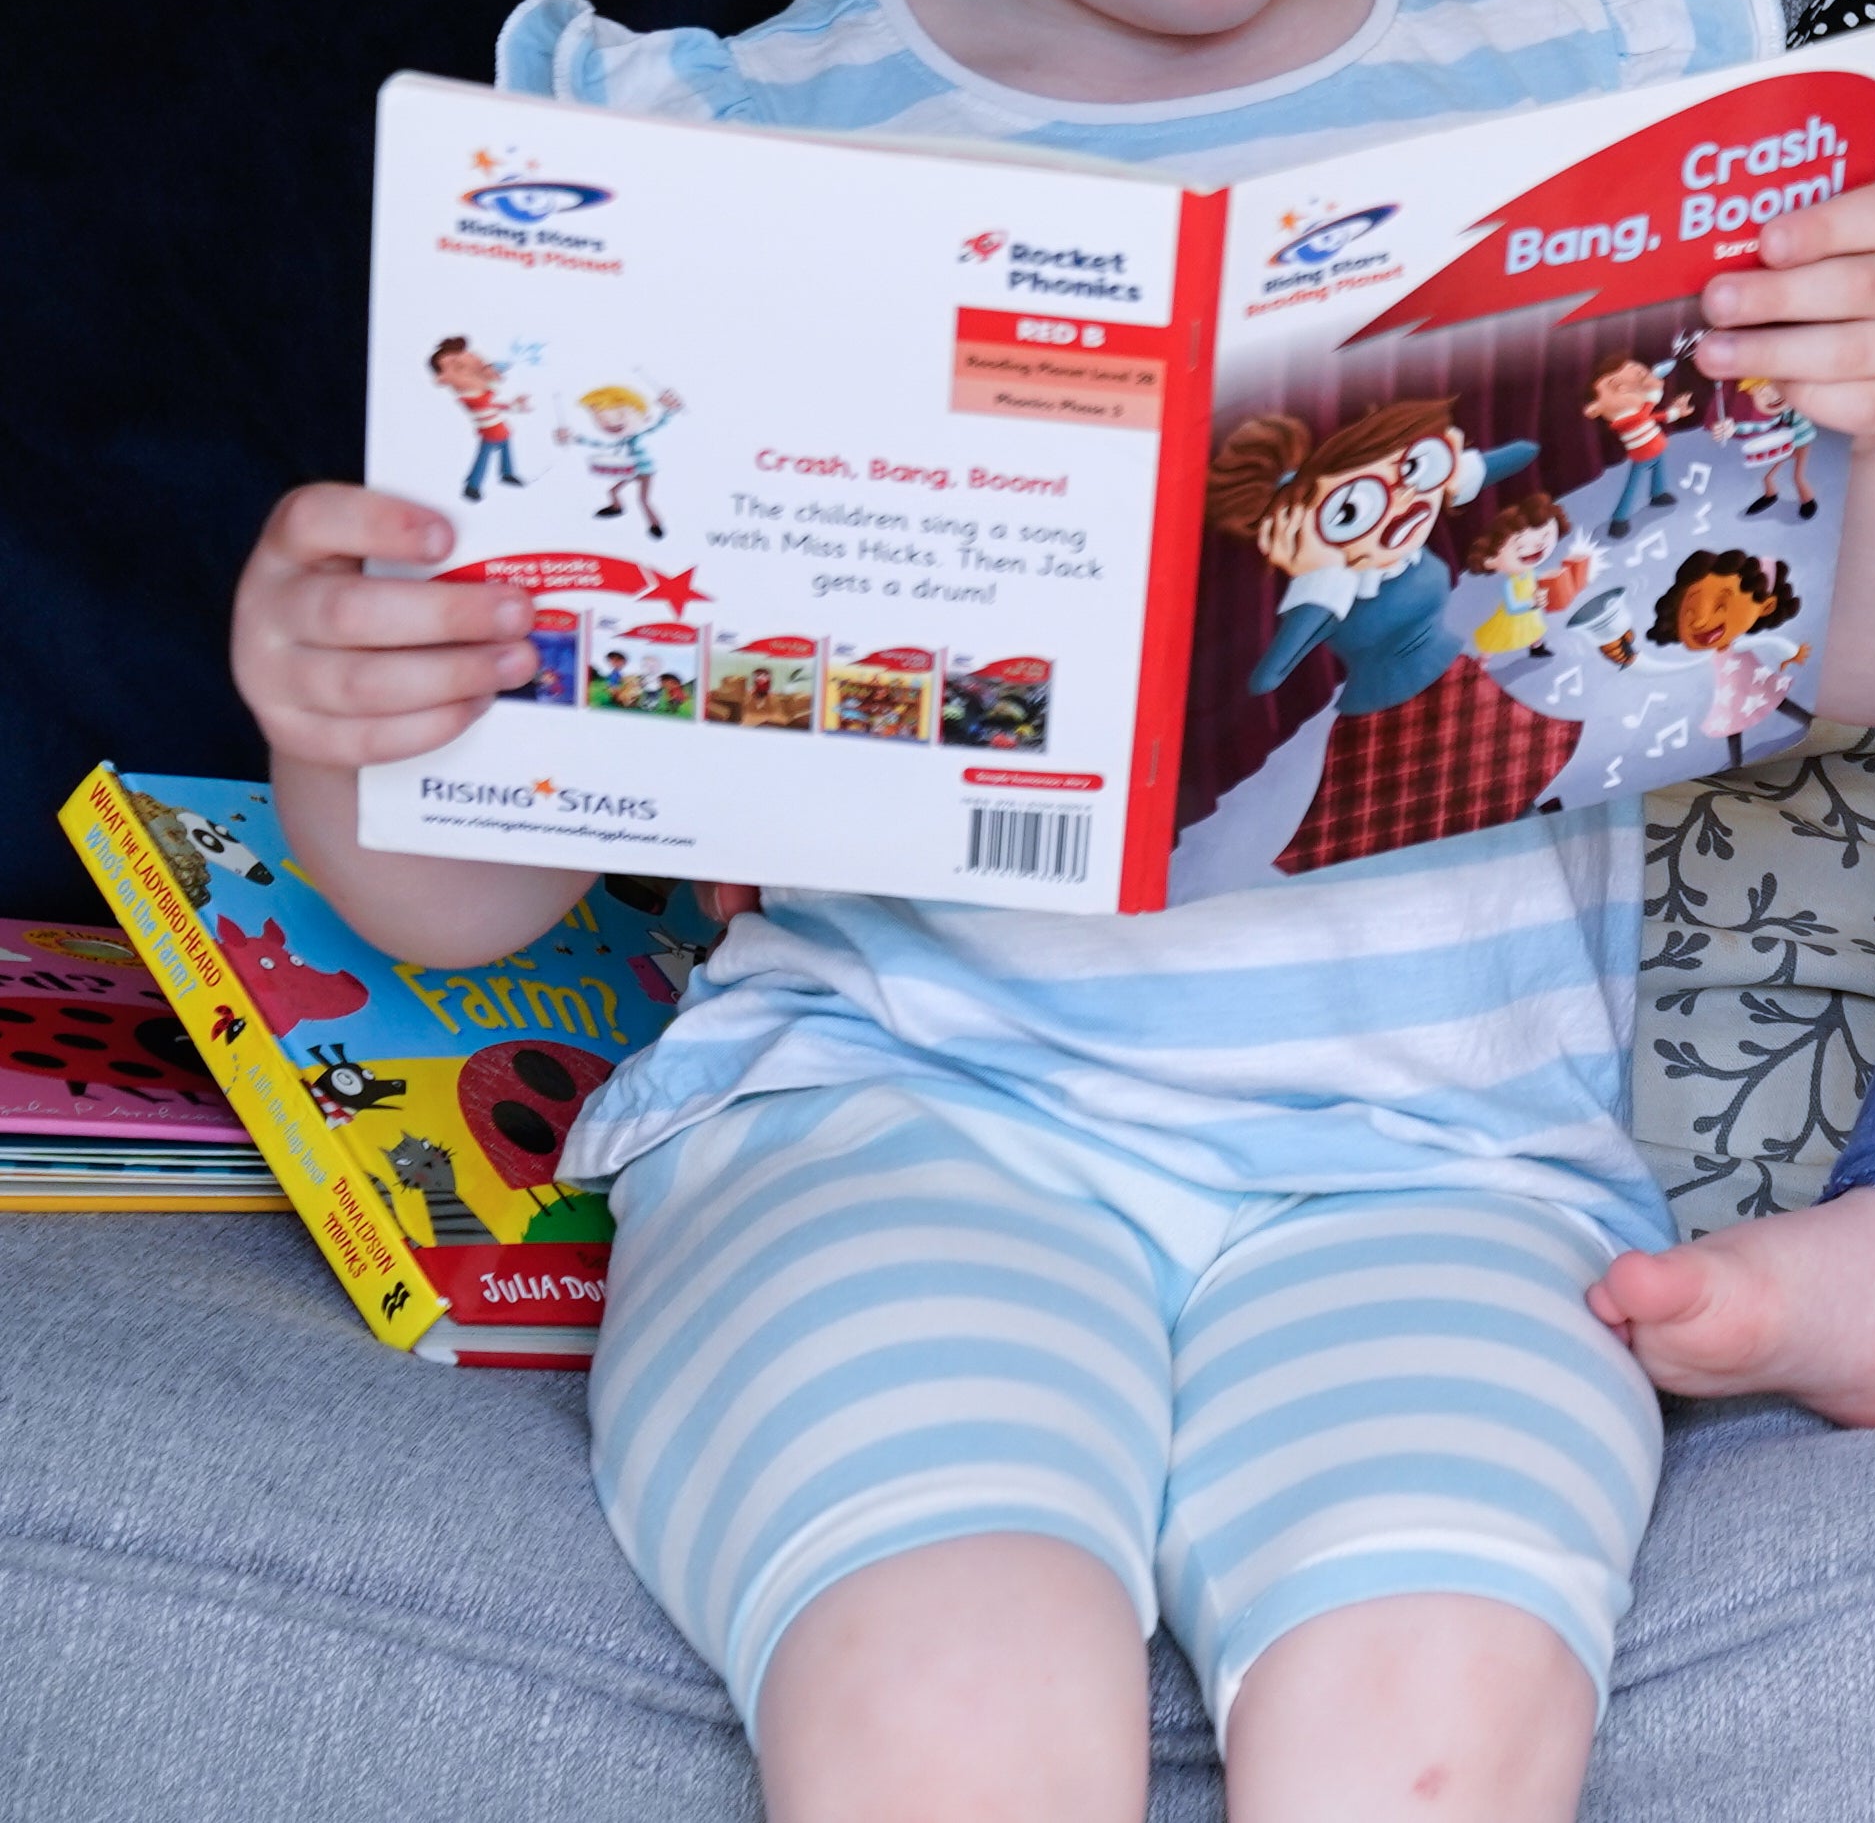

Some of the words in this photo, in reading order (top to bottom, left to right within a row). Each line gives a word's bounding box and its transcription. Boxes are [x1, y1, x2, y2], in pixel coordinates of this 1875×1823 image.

[1681, 115, 1849, 190] Crash,
[1504, 212, 1662, 276] Bang,
[1678, 157, 1847, 241] Boom!
[1007, 270, 1142, 301] Phonics
[1010, 243, 1126, 273] Rocket
[1263, 269, 1325, 294] Rising
[1331, 251, 1391, 276] Stars
[1016, 318, 1078, 345] RED
[1081, 324, 1106, 348] B
[755, 449, 858, 479] Crash,
[869, 458, 957, 491] Bang,
[968, 467, 1069, 496] Boom!
[731, 492, 783, 520] The
[794, 502, 909, 531] children
[920, 514, 978, 545] sing
[989, 521, 1007, 539] a
[1019, 525, 1087, 553] song
[705, 530, 770, 551] with
[780, 532, 846, 559] Miss
[857, 539, 944, 568] Hicks.
[957, 546, 1026, 574] Then
[1035, 554, 1104, 579] Jack
[811, 573, 871, 597] gets
[882, 579, 900, 597] a
[911, 577, 997, 604] drum!
[421, 776, 534, 808] RISING
[557, 788, 659, 821] STARS
[83, 822, 127, 881] Who's
[115, 877, 137, 908] on
[131, 897, 157, 939] the
[89, 780, 126, 837] WHAT
[119, 828, 140, 861] THE
[132, 851, 188, 935] LADYBIRD
[180, 925, 223, 989] HEARD
[391, 962, 631, 1046] Farm?
[245, 1064, 261, 1081] A
[254, 1074, 274, 1102] lift
[267, 1095, 288, 1127] the
[282, 1119, 308, 1157] flap
[300, 1144, 329, 1188] book
[321, 1211, 369, 1280] MONKS
[331, 1175, 397, 1277] DONALDSON
[479, 1271, 562, 1304] JULIA
